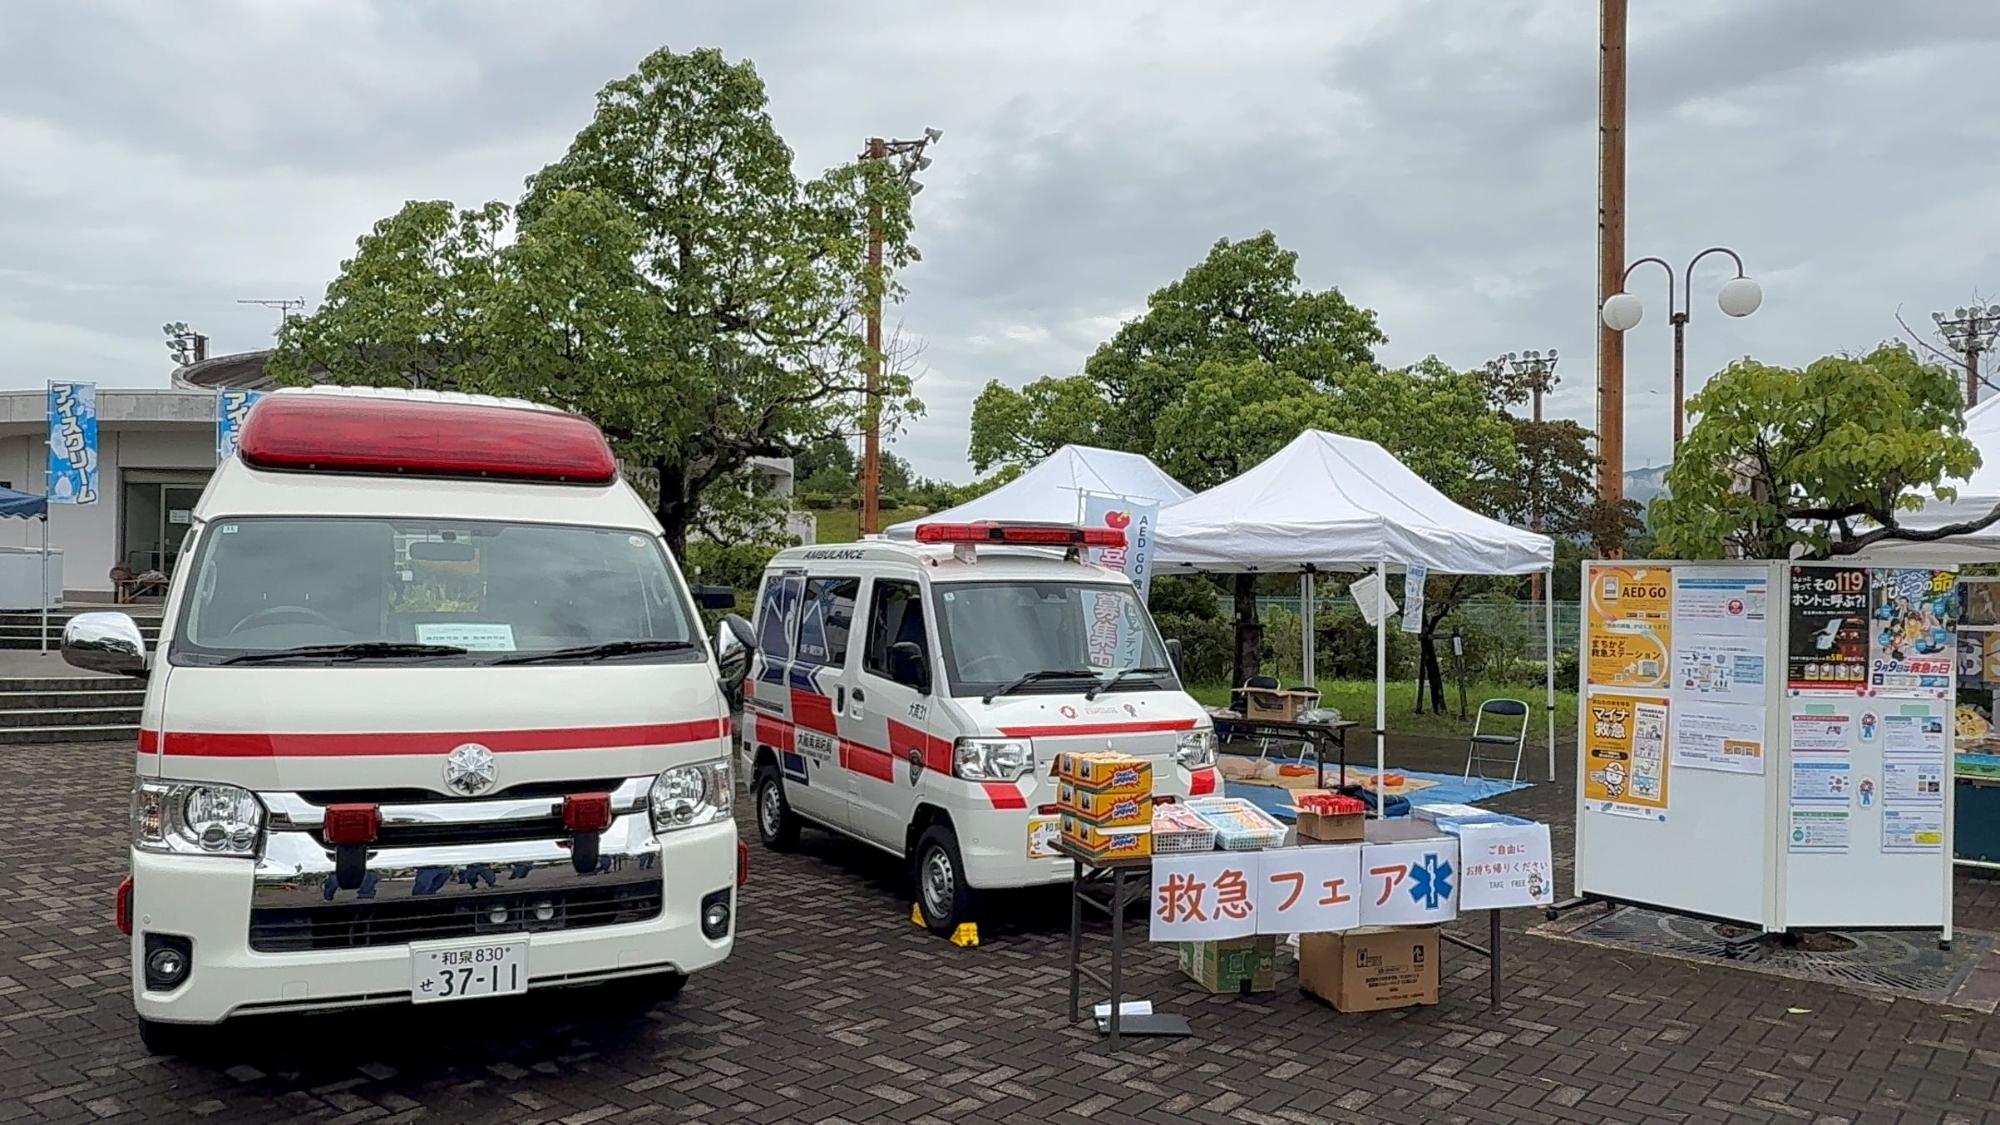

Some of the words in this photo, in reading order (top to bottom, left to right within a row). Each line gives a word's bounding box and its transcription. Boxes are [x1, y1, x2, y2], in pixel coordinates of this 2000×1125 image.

[53, 384, 97, 504] アイスクリーム
[1139, 515, 1149, 548] AED
[803, 549, 866, 560] AMBULANCE
[1135, 553, 1145, 575] GO
[1622, 587, 1646, 598] AED
[1649, 587, 1666, 598] GO
[1592, 640, 1626, 650] まちかど
[1591, 648, 1661, 660] 救急ステーション
[1873, 660, 1951, 674] 9月9日は救急の日
[1592, 707, 1631, 722] マイナ
[1594, 722, 1627, 739] 救急
[1488, 844, 1526, 855] ご自由に
[1466, 861, 1549, 876] お持ち帰りください
[1489, 881, 1504, 889] TAKE
[1511, 879, 1526, 888] FREE
[1156, 865, 1407, 924] 救急フェア
[438, 963, 517, 997] 37-11
